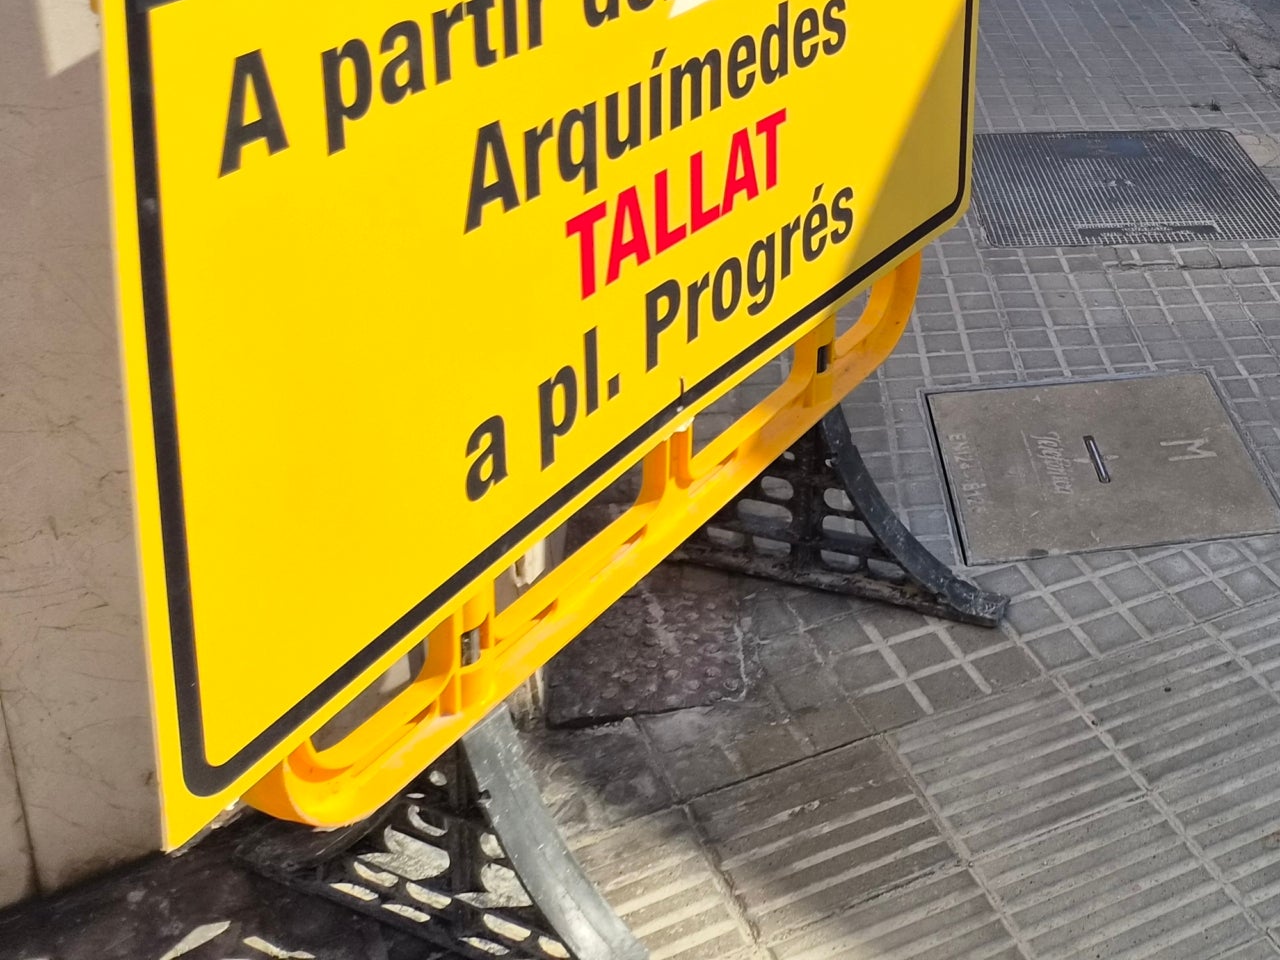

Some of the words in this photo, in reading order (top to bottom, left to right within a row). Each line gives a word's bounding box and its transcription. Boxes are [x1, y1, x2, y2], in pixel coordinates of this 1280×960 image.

[218, 48, 291, 179] A
[565, 107, 788, 301] TALLAT
[465, 413, 509, 503] a
[536, 326, 622, 473] pl.
[645, 182, 855, 375] Progrés
